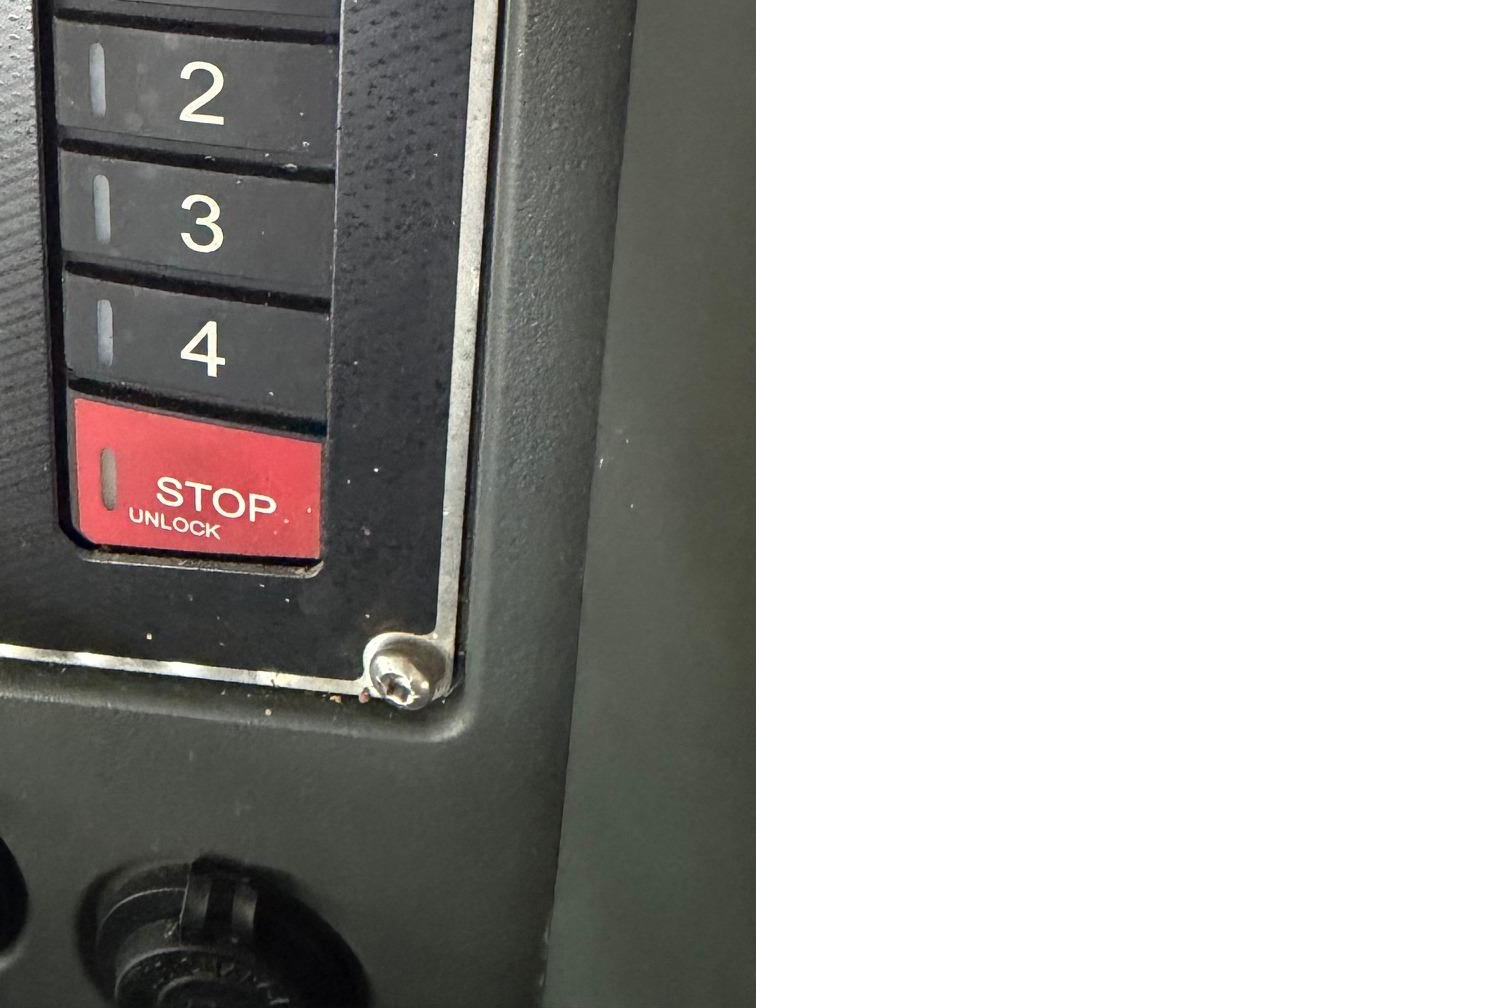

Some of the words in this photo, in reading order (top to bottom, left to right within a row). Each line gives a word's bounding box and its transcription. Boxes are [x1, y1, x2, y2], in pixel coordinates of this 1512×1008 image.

[179, 61, 225, 125] 2
[179, 193, 225, 254] 3
[180, 320, 226, 378] 4
[128, 506, 221, 541] UNLOCK
[156, 476, 277, 523] STOP
